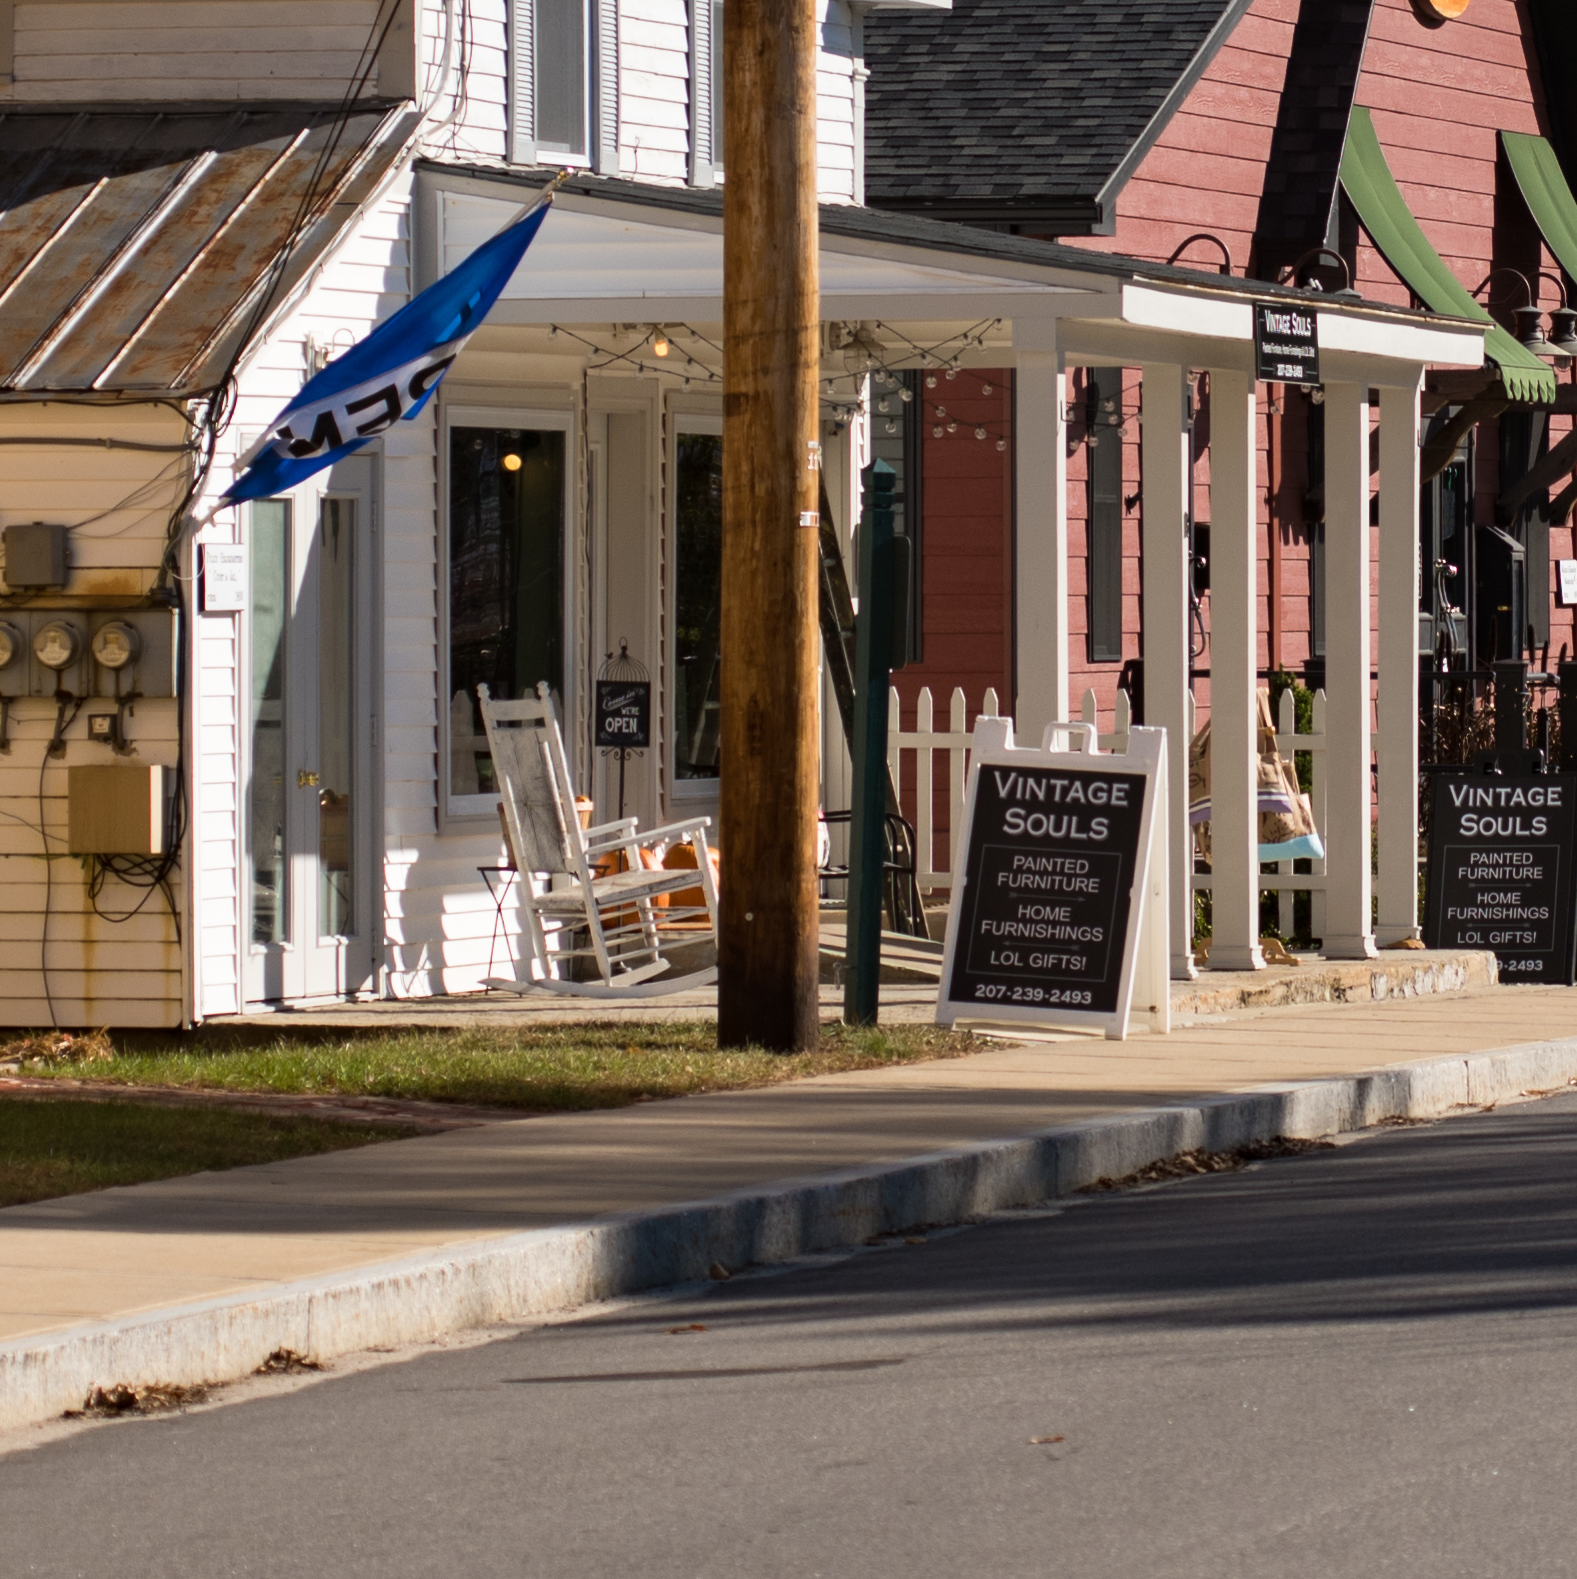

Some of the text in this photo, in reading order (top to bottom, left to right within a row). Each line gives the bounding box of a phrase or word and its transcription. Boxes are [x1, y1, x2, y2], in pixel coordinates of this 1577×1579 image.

[621, 706, 639, 715] WE'RE
[605, 717, 637, 733] OPEN
[994, 771, 1130, 807] VINTAGE
[1449, 784, 1562, 807] VINTAGE
[1002, 807, 1110, 840] SOULS
[1459, 813, 1547, 837] SOULS
[1013, 856, 1089, 874] PAINTED
[1470, 852, 1533, 865] PAINTED
[1458, 867, 1543, 880] FURNITURE
[997, 872, 1100, 893] FURNITURE
[1477, 892, 1521, 905] HOME
[1017, 905, 1072, 922] HOME
[1447, 907, 1549, 920] FURNISHINGS
[980, 920, 1104, 942] FURNISHINGS
[1457, 931, 1537, 944] LOL GIFTS!
[990, 950, 1086, 971] LOL GIFTS!
[1496, 960, 1543, 971] 9-2493
[974, 984, 1092, 1004] 207-239-2493
